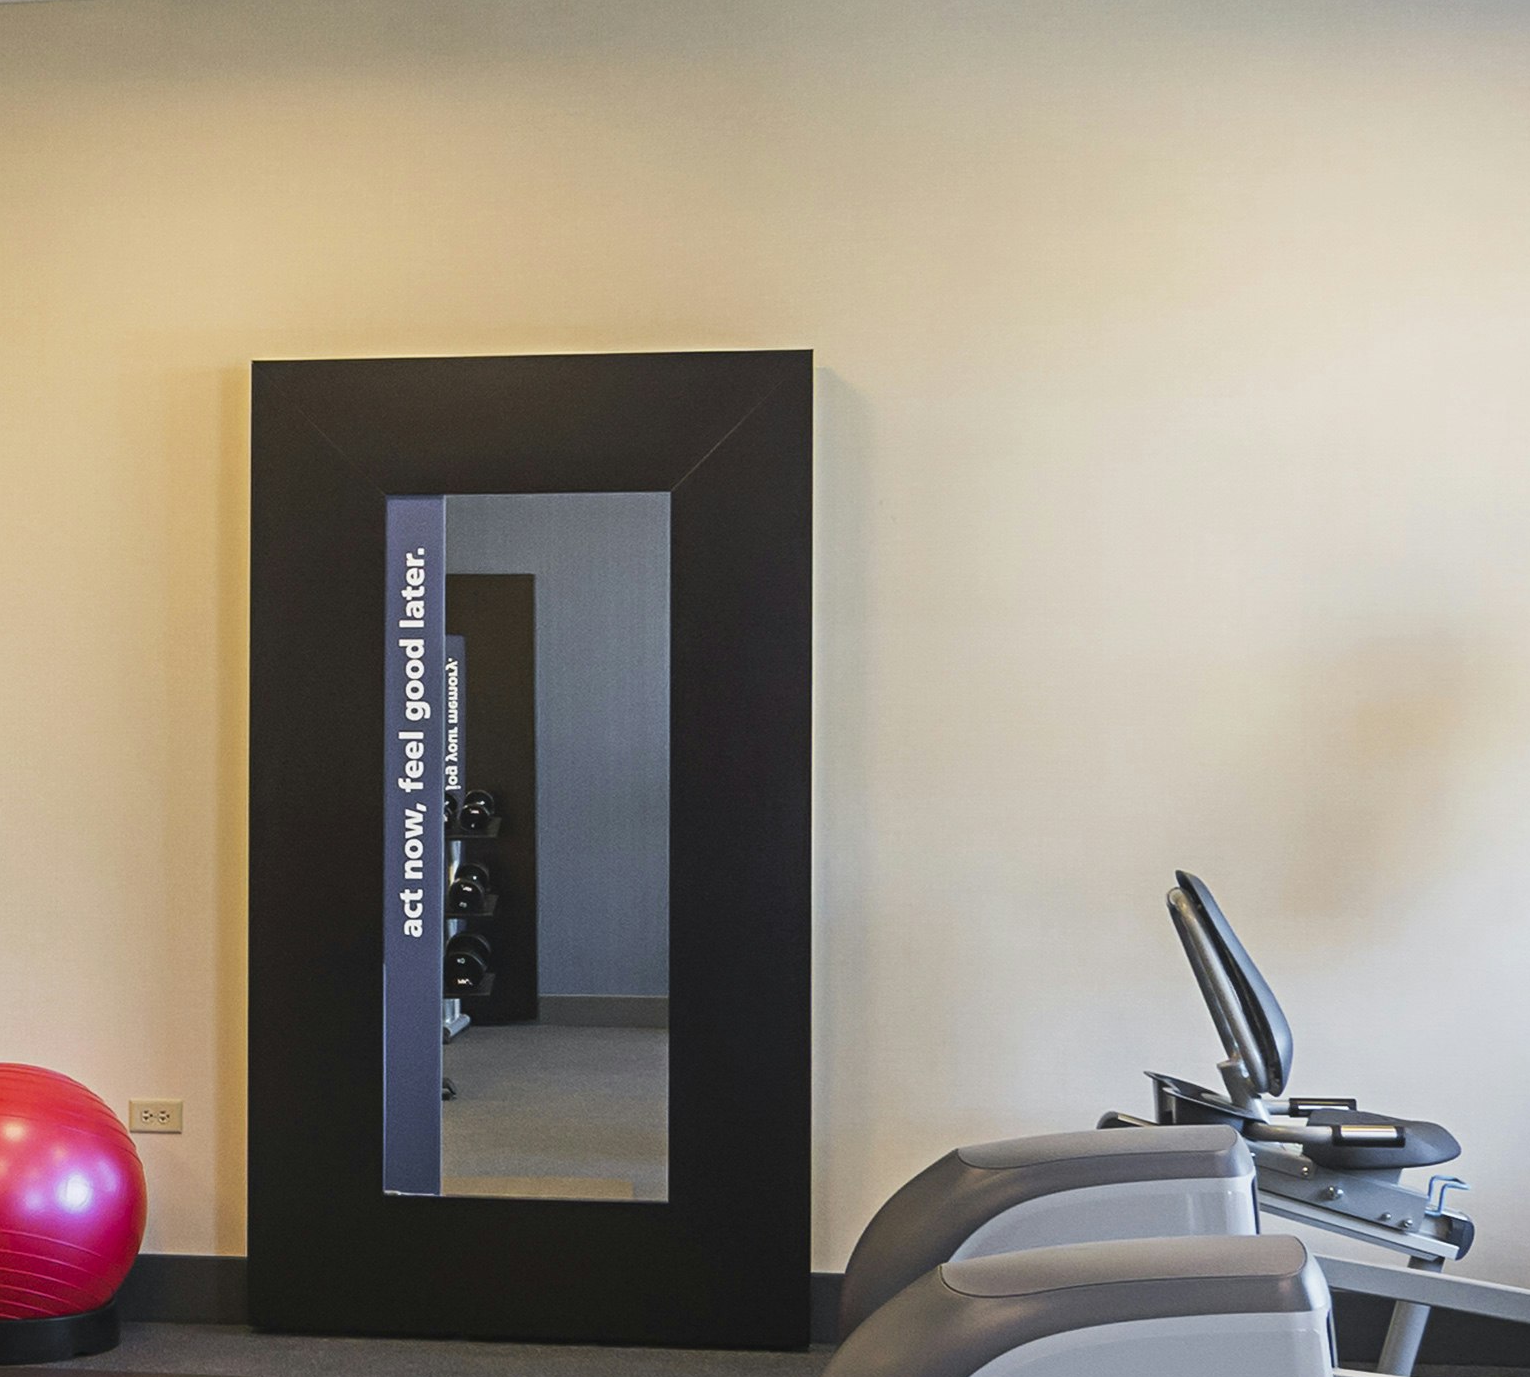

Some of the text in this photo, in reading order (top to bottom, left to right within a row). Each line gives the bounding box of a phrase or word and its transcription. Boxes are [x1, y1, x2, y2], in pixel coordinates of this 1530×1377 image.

[398, 548, 431, 937] act now, feel good later.
